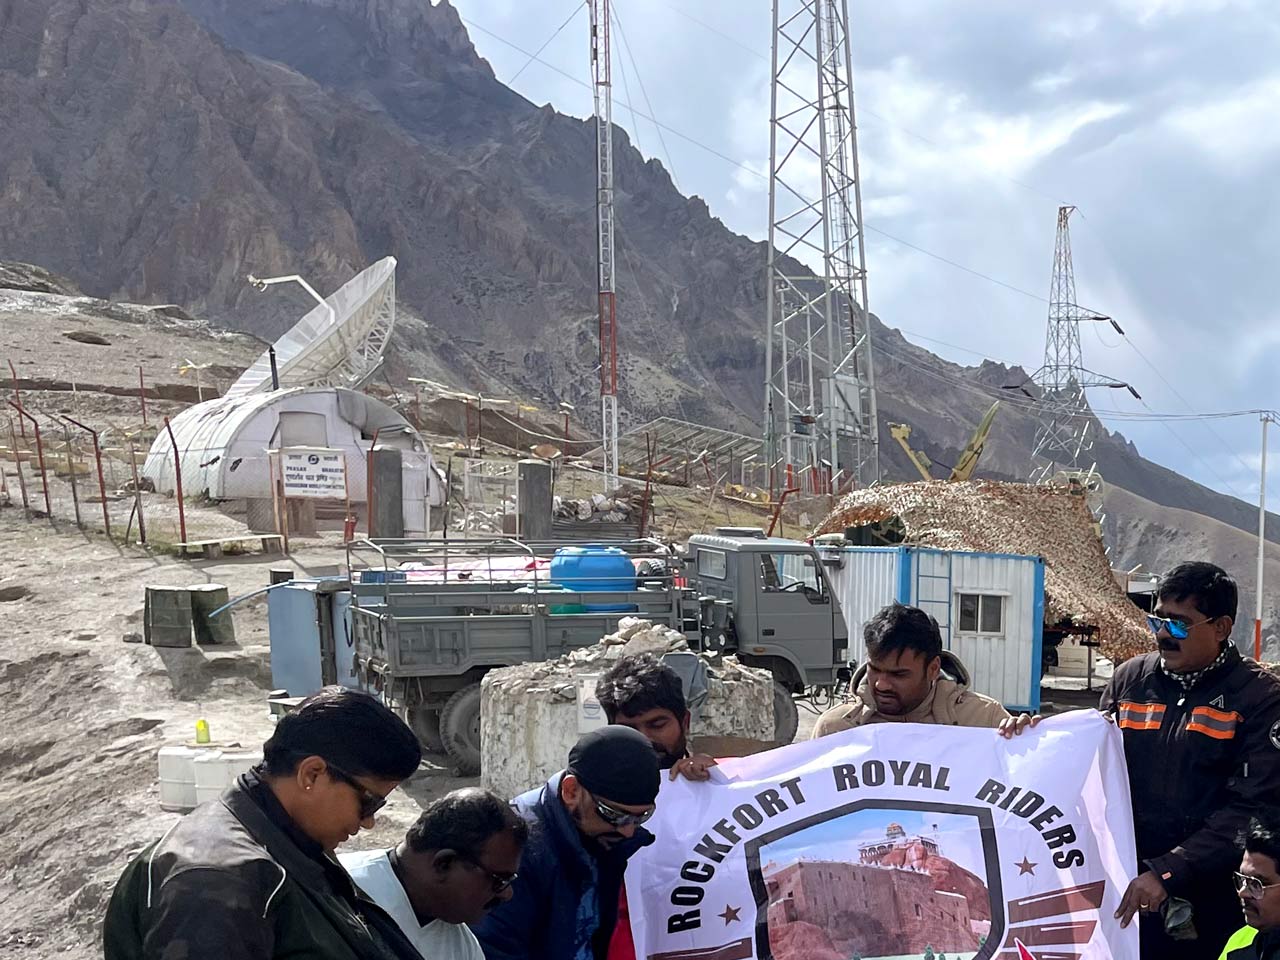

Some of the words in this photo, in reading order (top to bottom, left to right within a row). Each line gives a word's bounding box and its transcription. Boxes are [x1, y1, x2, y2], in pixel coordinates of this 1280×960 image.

[667, 777, 806, 934] ROCKFORT
[833, 760, 950, 793] ROYAL
[975, 778, 1085, 870] RIDERS
